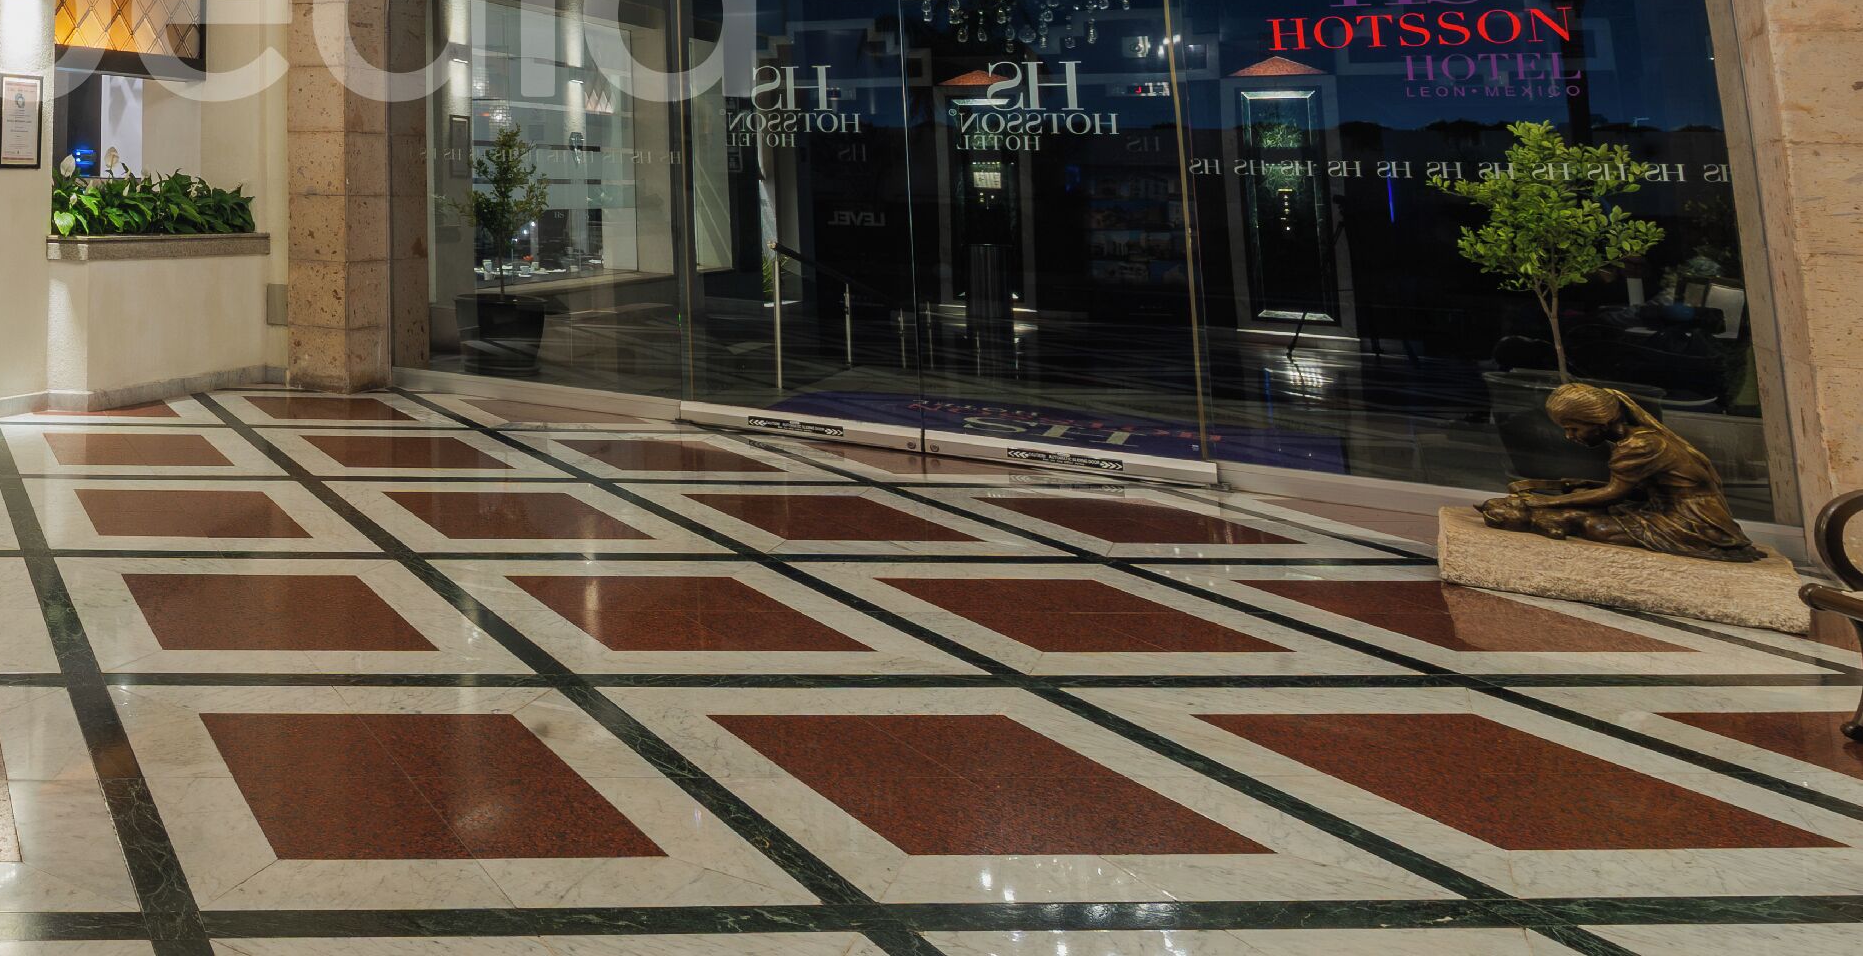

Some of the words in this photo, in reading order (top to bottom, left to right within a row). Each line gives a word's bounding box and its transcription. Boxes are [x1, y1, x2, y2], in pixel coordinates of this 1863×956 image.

[1266, 7, 1573, 51] HOTSSON
[1401, 51, 1581, 81] HOTEL
[1406, 85, 1466, 98] LEON
[1485, 84, 1581, 98] MEXICO
